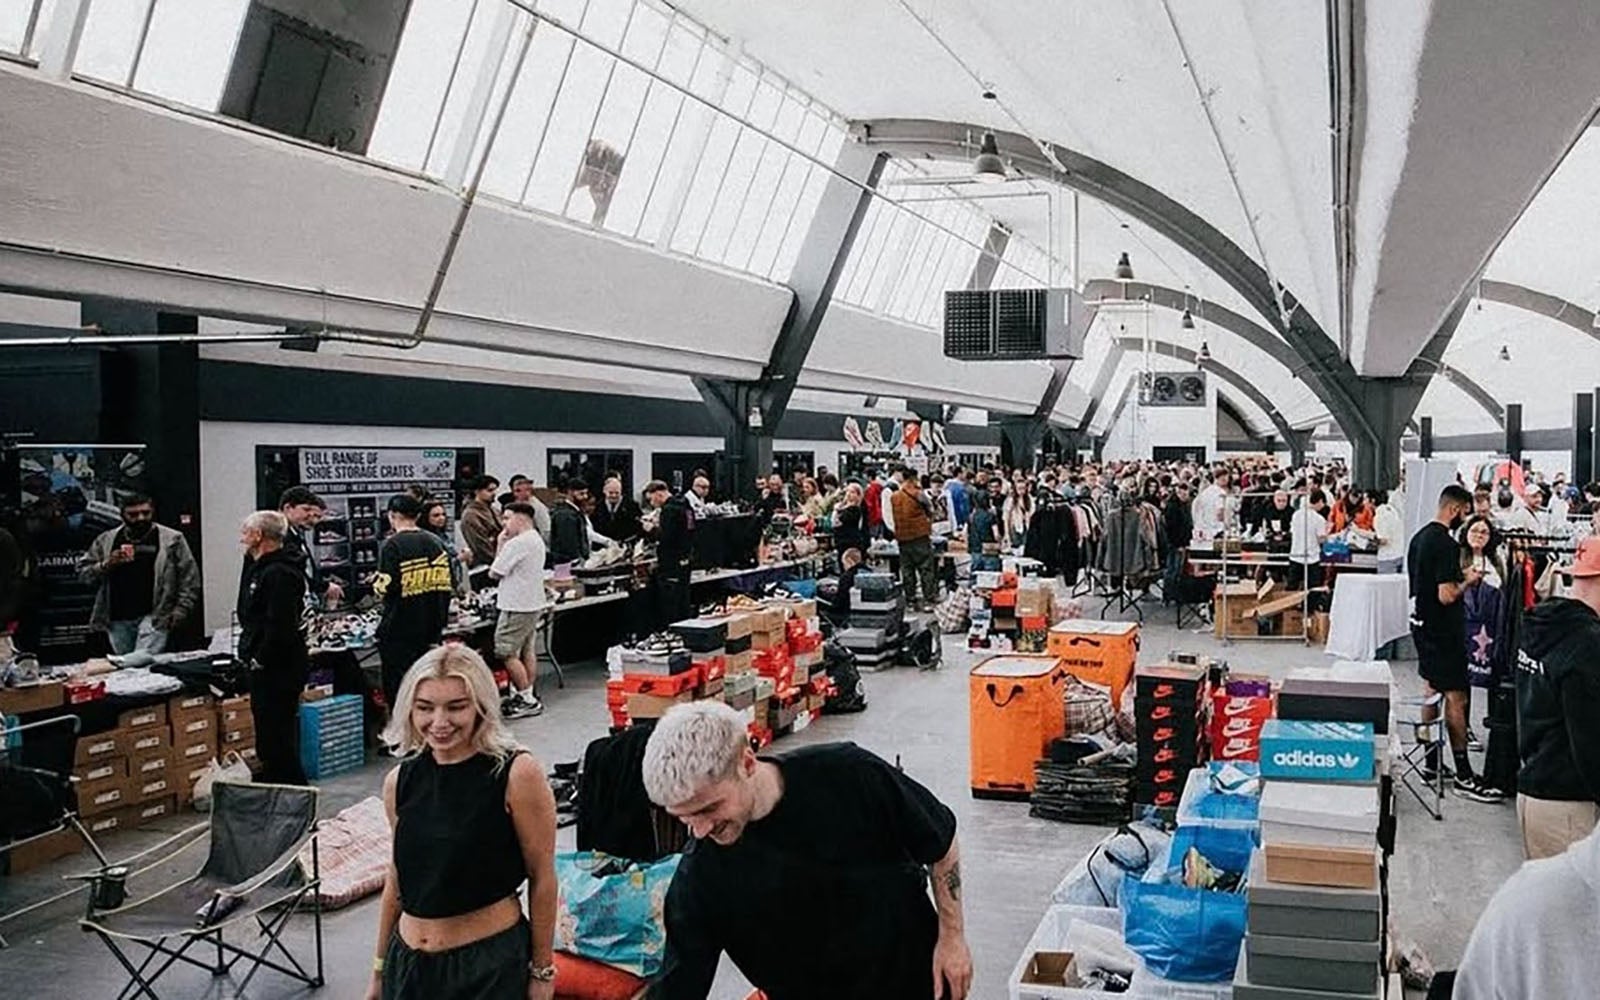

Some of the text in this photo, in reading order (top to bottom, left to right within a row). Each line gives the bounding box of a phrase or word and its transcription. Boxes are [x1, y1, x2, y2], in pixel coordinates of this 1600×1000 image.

[305, 452, 378, 465] FULL RANGE OF
[306, 466, 332, 479] SHOE
[335, 466, 377, 479] STORAGE
[380, 465, 415, 479] CRATES
[1273, 749, 1337, 768] adidas
